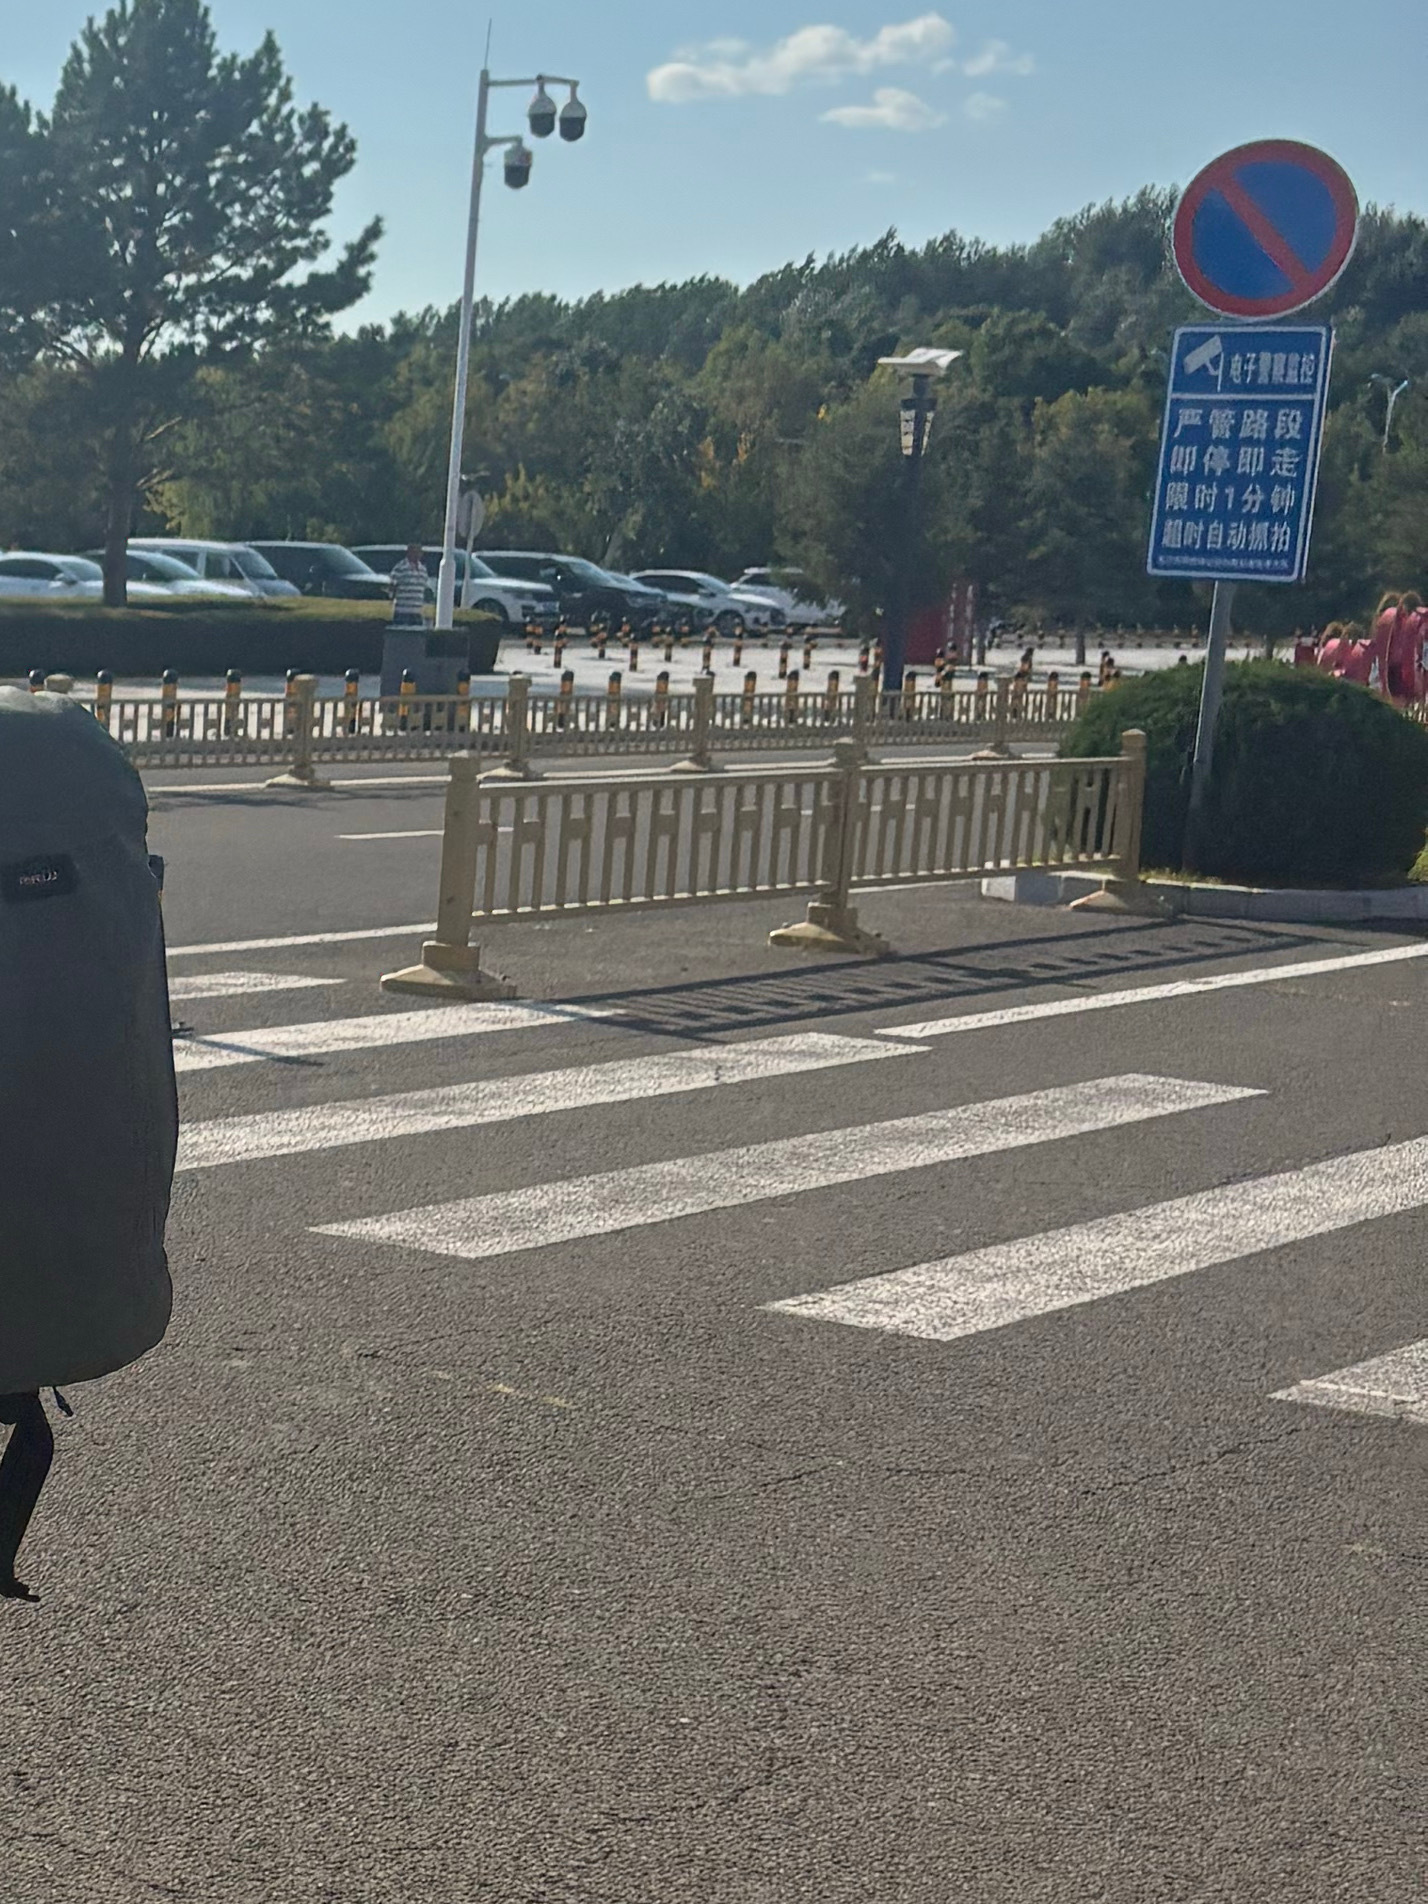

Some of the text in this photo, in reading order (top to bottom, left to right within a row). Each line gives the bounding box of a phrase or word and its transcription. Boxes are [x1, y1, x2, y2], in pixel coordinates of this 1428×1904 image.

[1174, 408, 1303, 440] 严管路段
[1170, 445, 1303, 477] 即停即走
[1165, 482, 1296, 516] 限时1分钟
